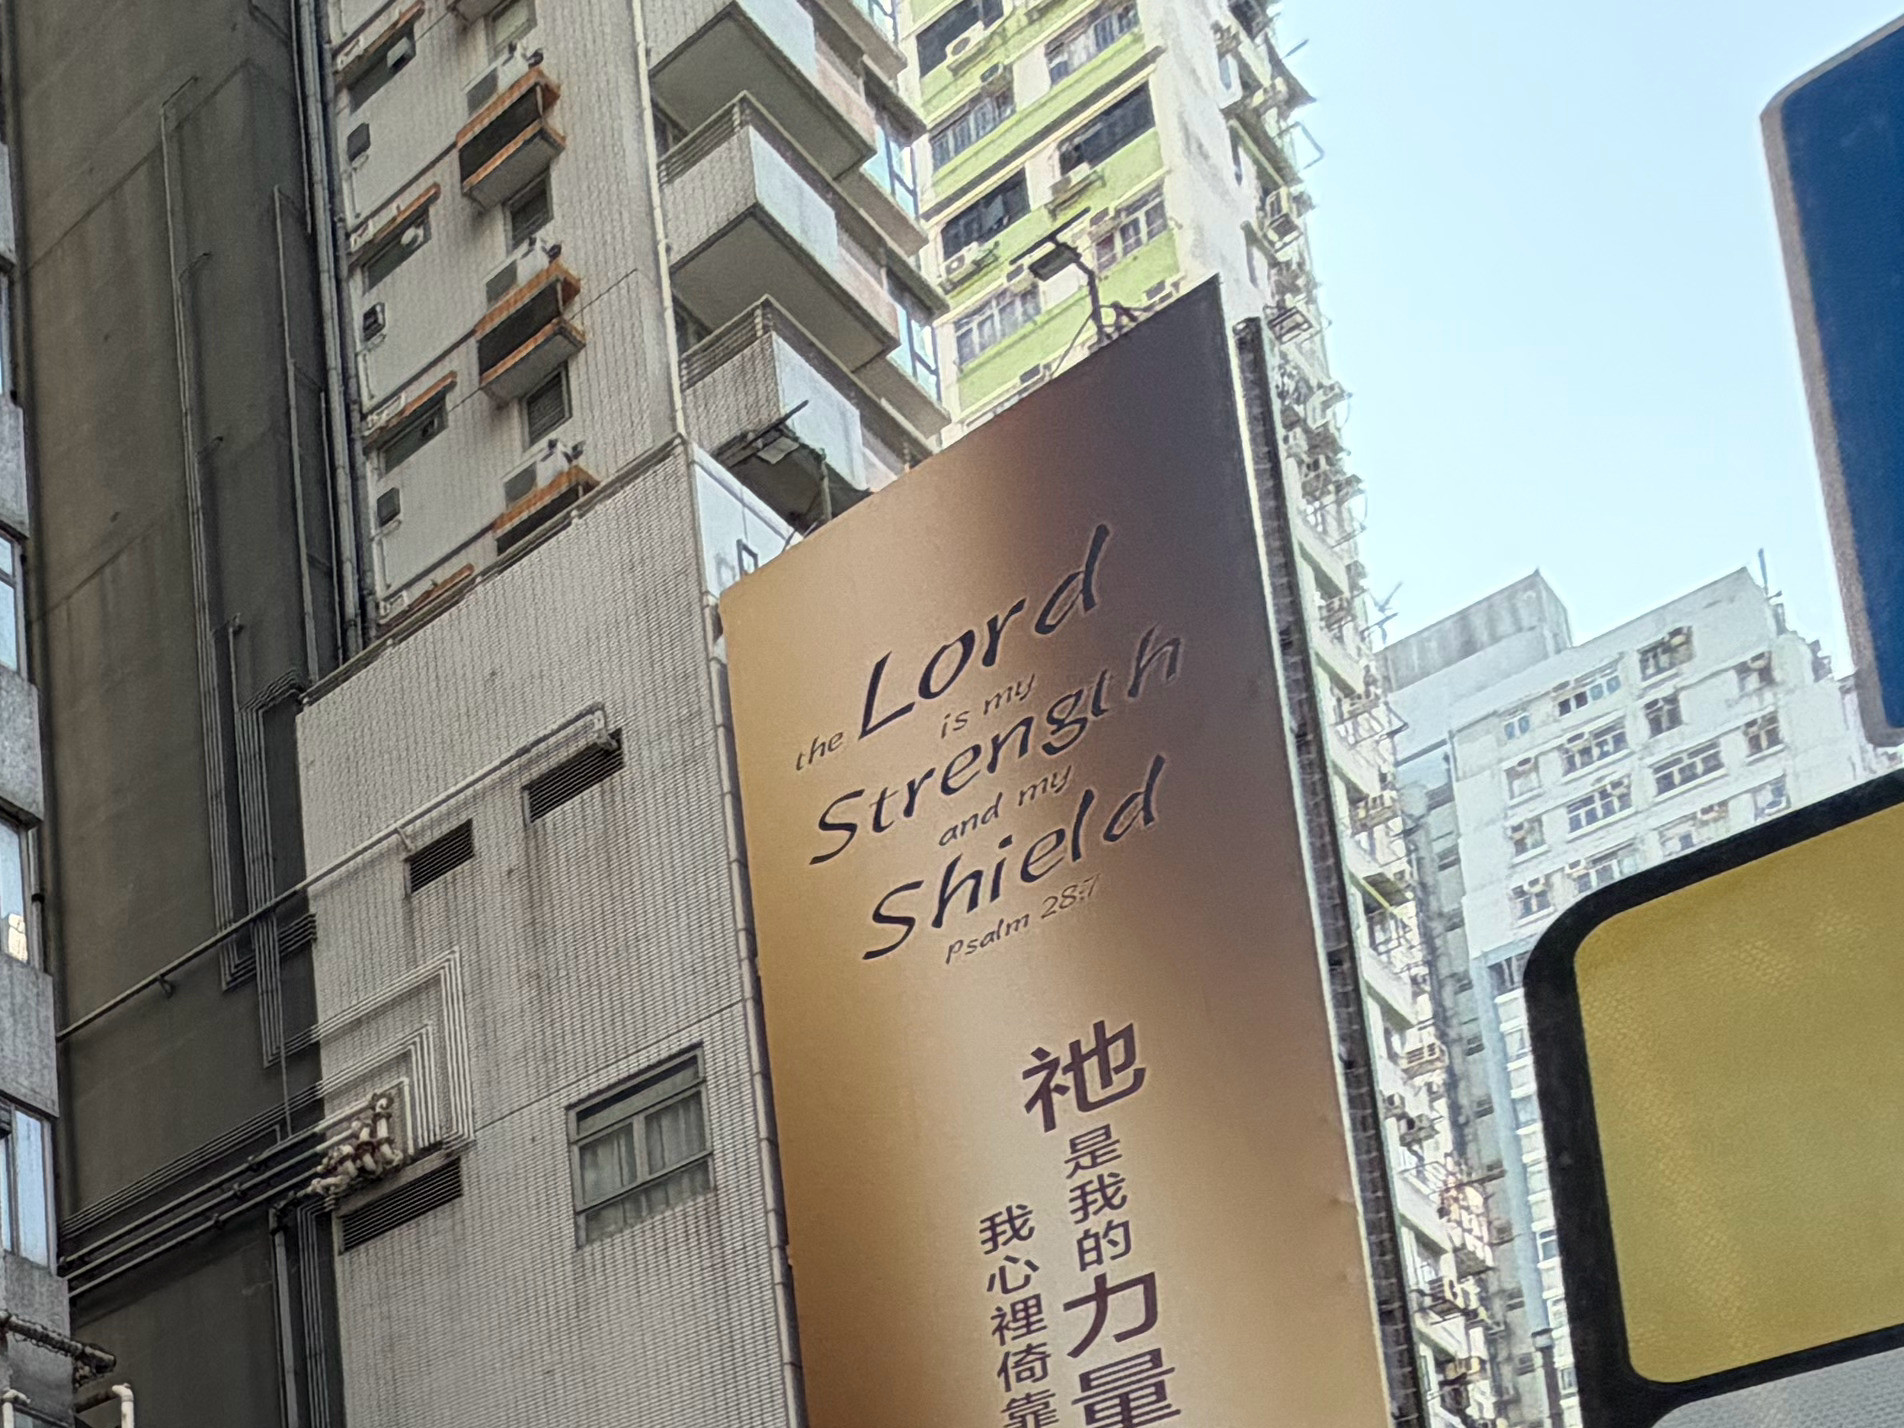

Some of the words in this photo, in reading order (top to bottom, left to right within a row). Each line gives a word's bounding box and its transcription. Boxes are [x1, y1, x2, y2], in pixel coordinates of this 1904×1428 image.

[796, 731, 843, 771] the
[859, 523, 1109, 741] Lord
[941, 711, 968, 738] is
[983, 673, 1035, 716] my
[809, 624, 1182, 865] Strength
[938, 792, 1003, 847] and
[1018, 764, 1072, 807] my
[863, 754, 1165, 960] Shield
[945, 912, 1030, 964] Psalm
[1041, 872, 1101, 919] 28:7
